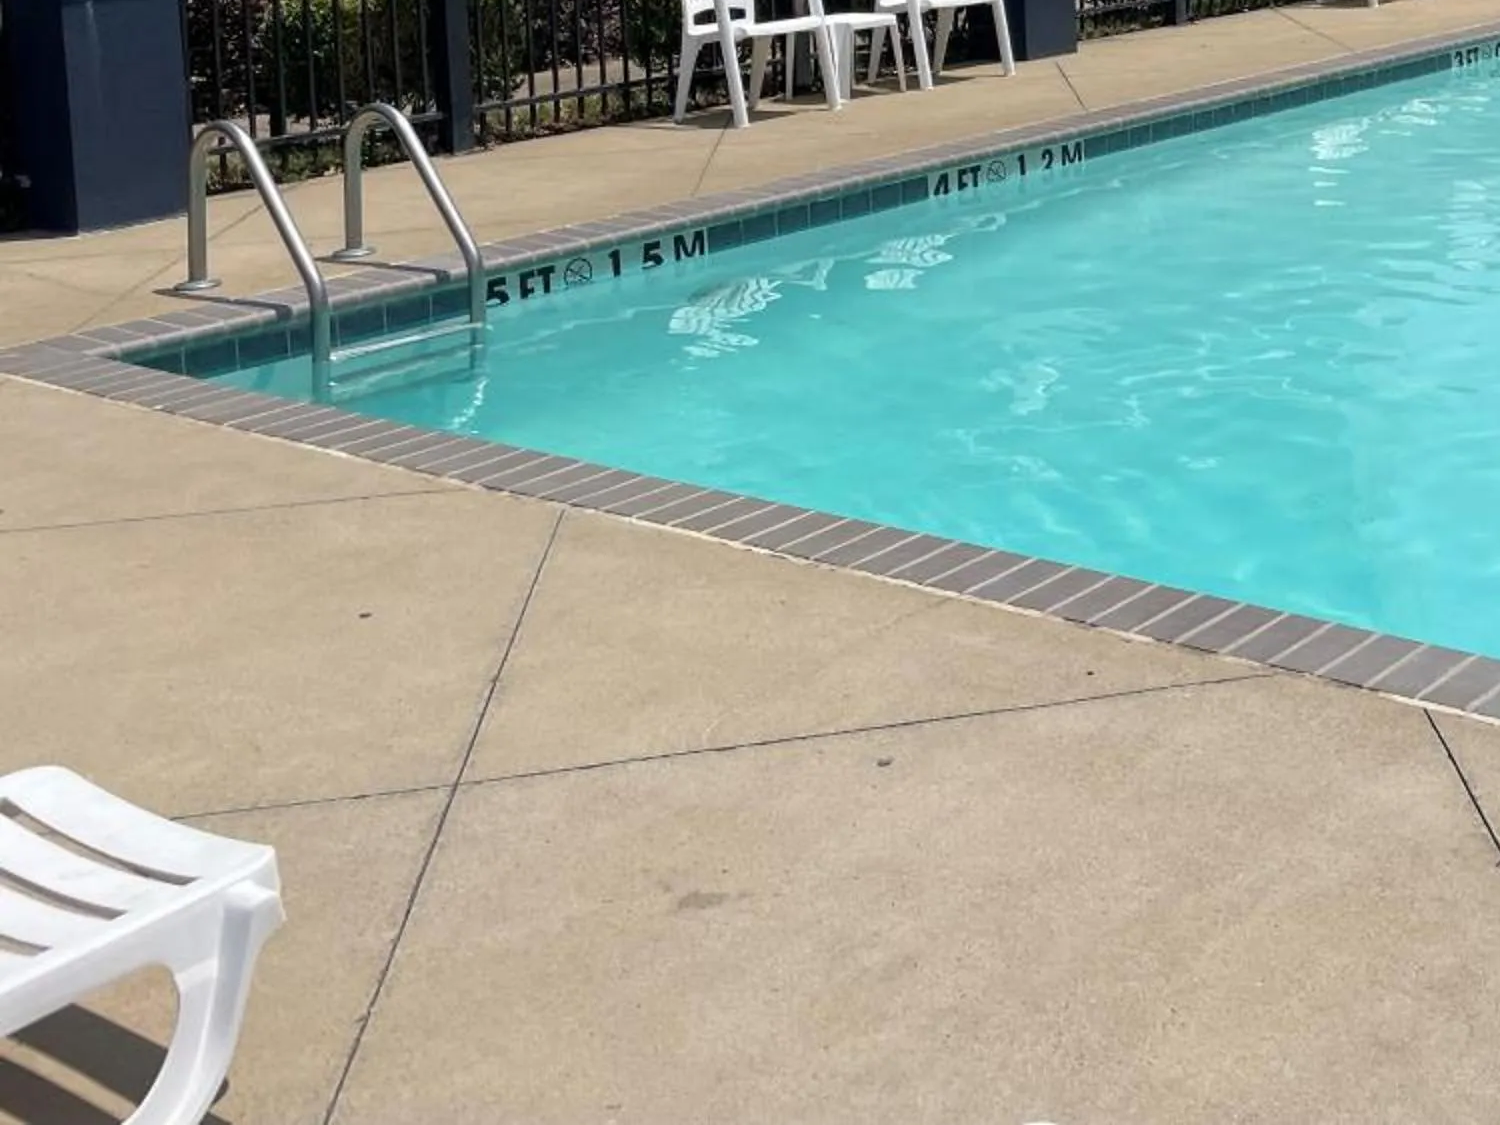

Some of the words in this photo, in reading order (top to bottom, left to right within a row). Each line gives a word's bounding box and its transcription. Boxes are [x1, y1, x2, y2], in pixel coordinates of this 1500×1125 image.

[1061, 141, 1083, 166] M
[485, 277, 510, 307] 5
[519, 265, 556, 300] FT
[673, 230, 705, 262] M
